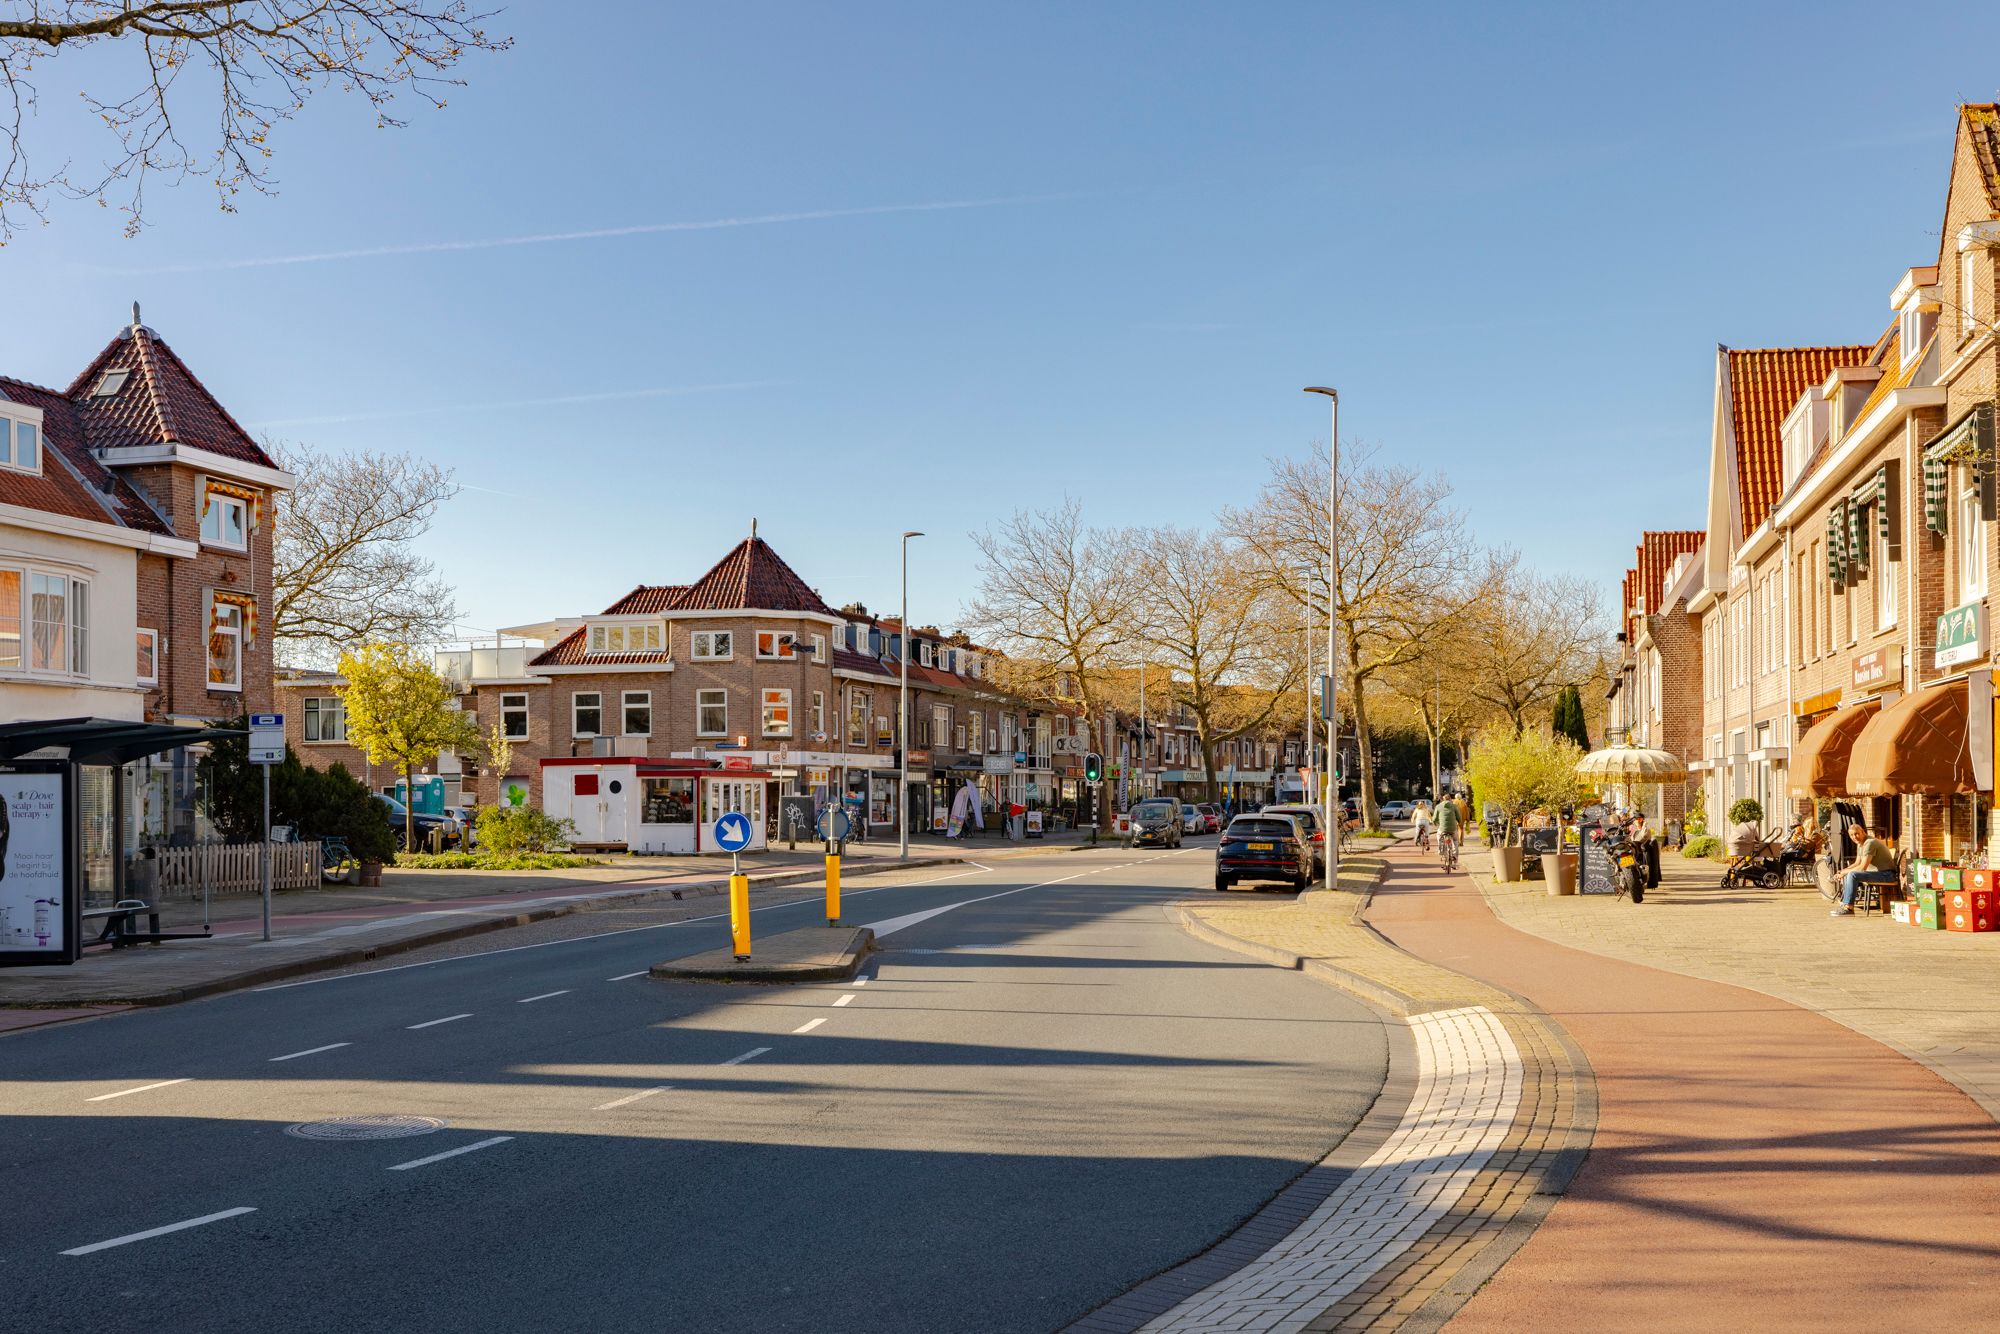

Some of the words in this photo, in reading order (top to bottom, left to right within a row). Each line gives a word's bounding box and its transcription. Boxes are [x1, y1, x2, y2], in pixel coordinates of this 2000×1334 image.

[29, 790, 54, 800] Dove
[12, 802, 32, 811] scalp
[12, 811, 40, 820] therapy
[16, 862, 40, 871] begint
[1585, 879, 1611, 891] OPEN
